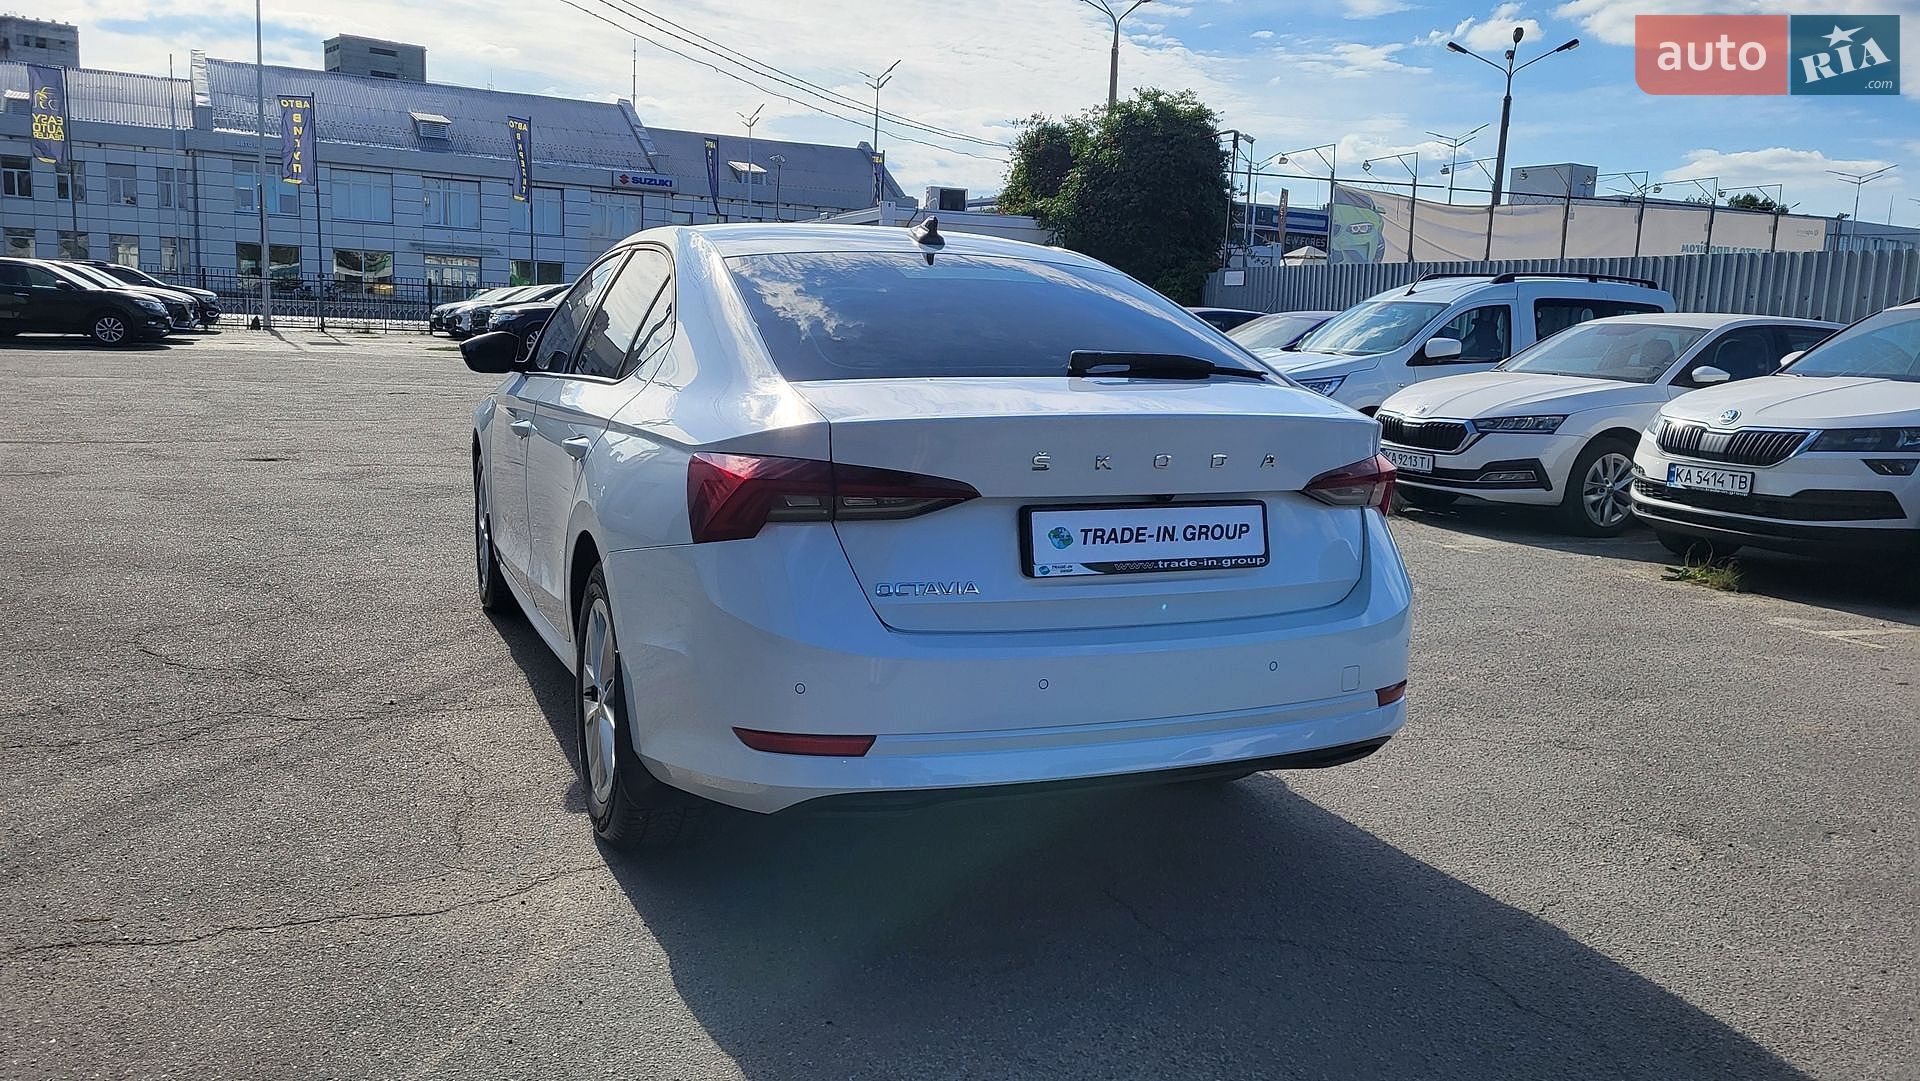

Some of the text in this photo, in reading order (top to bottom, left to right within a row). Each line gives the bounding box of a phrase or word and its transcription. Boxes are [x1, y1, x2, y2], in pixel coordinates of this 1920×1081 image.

[631, 175, 673, 188] SUZUKI
[1031, 452, 1276, 472] ŠKODA
[1398, 453, 1418, 467] 9213
[1675, 467, 1748, 490] KA 5414 TB
[1183, 523, 1250, 542] GROUP
[1114, 555, 1266, 571] www.trade-in.group
[875, 580, 981, 598] OCTAVIA
